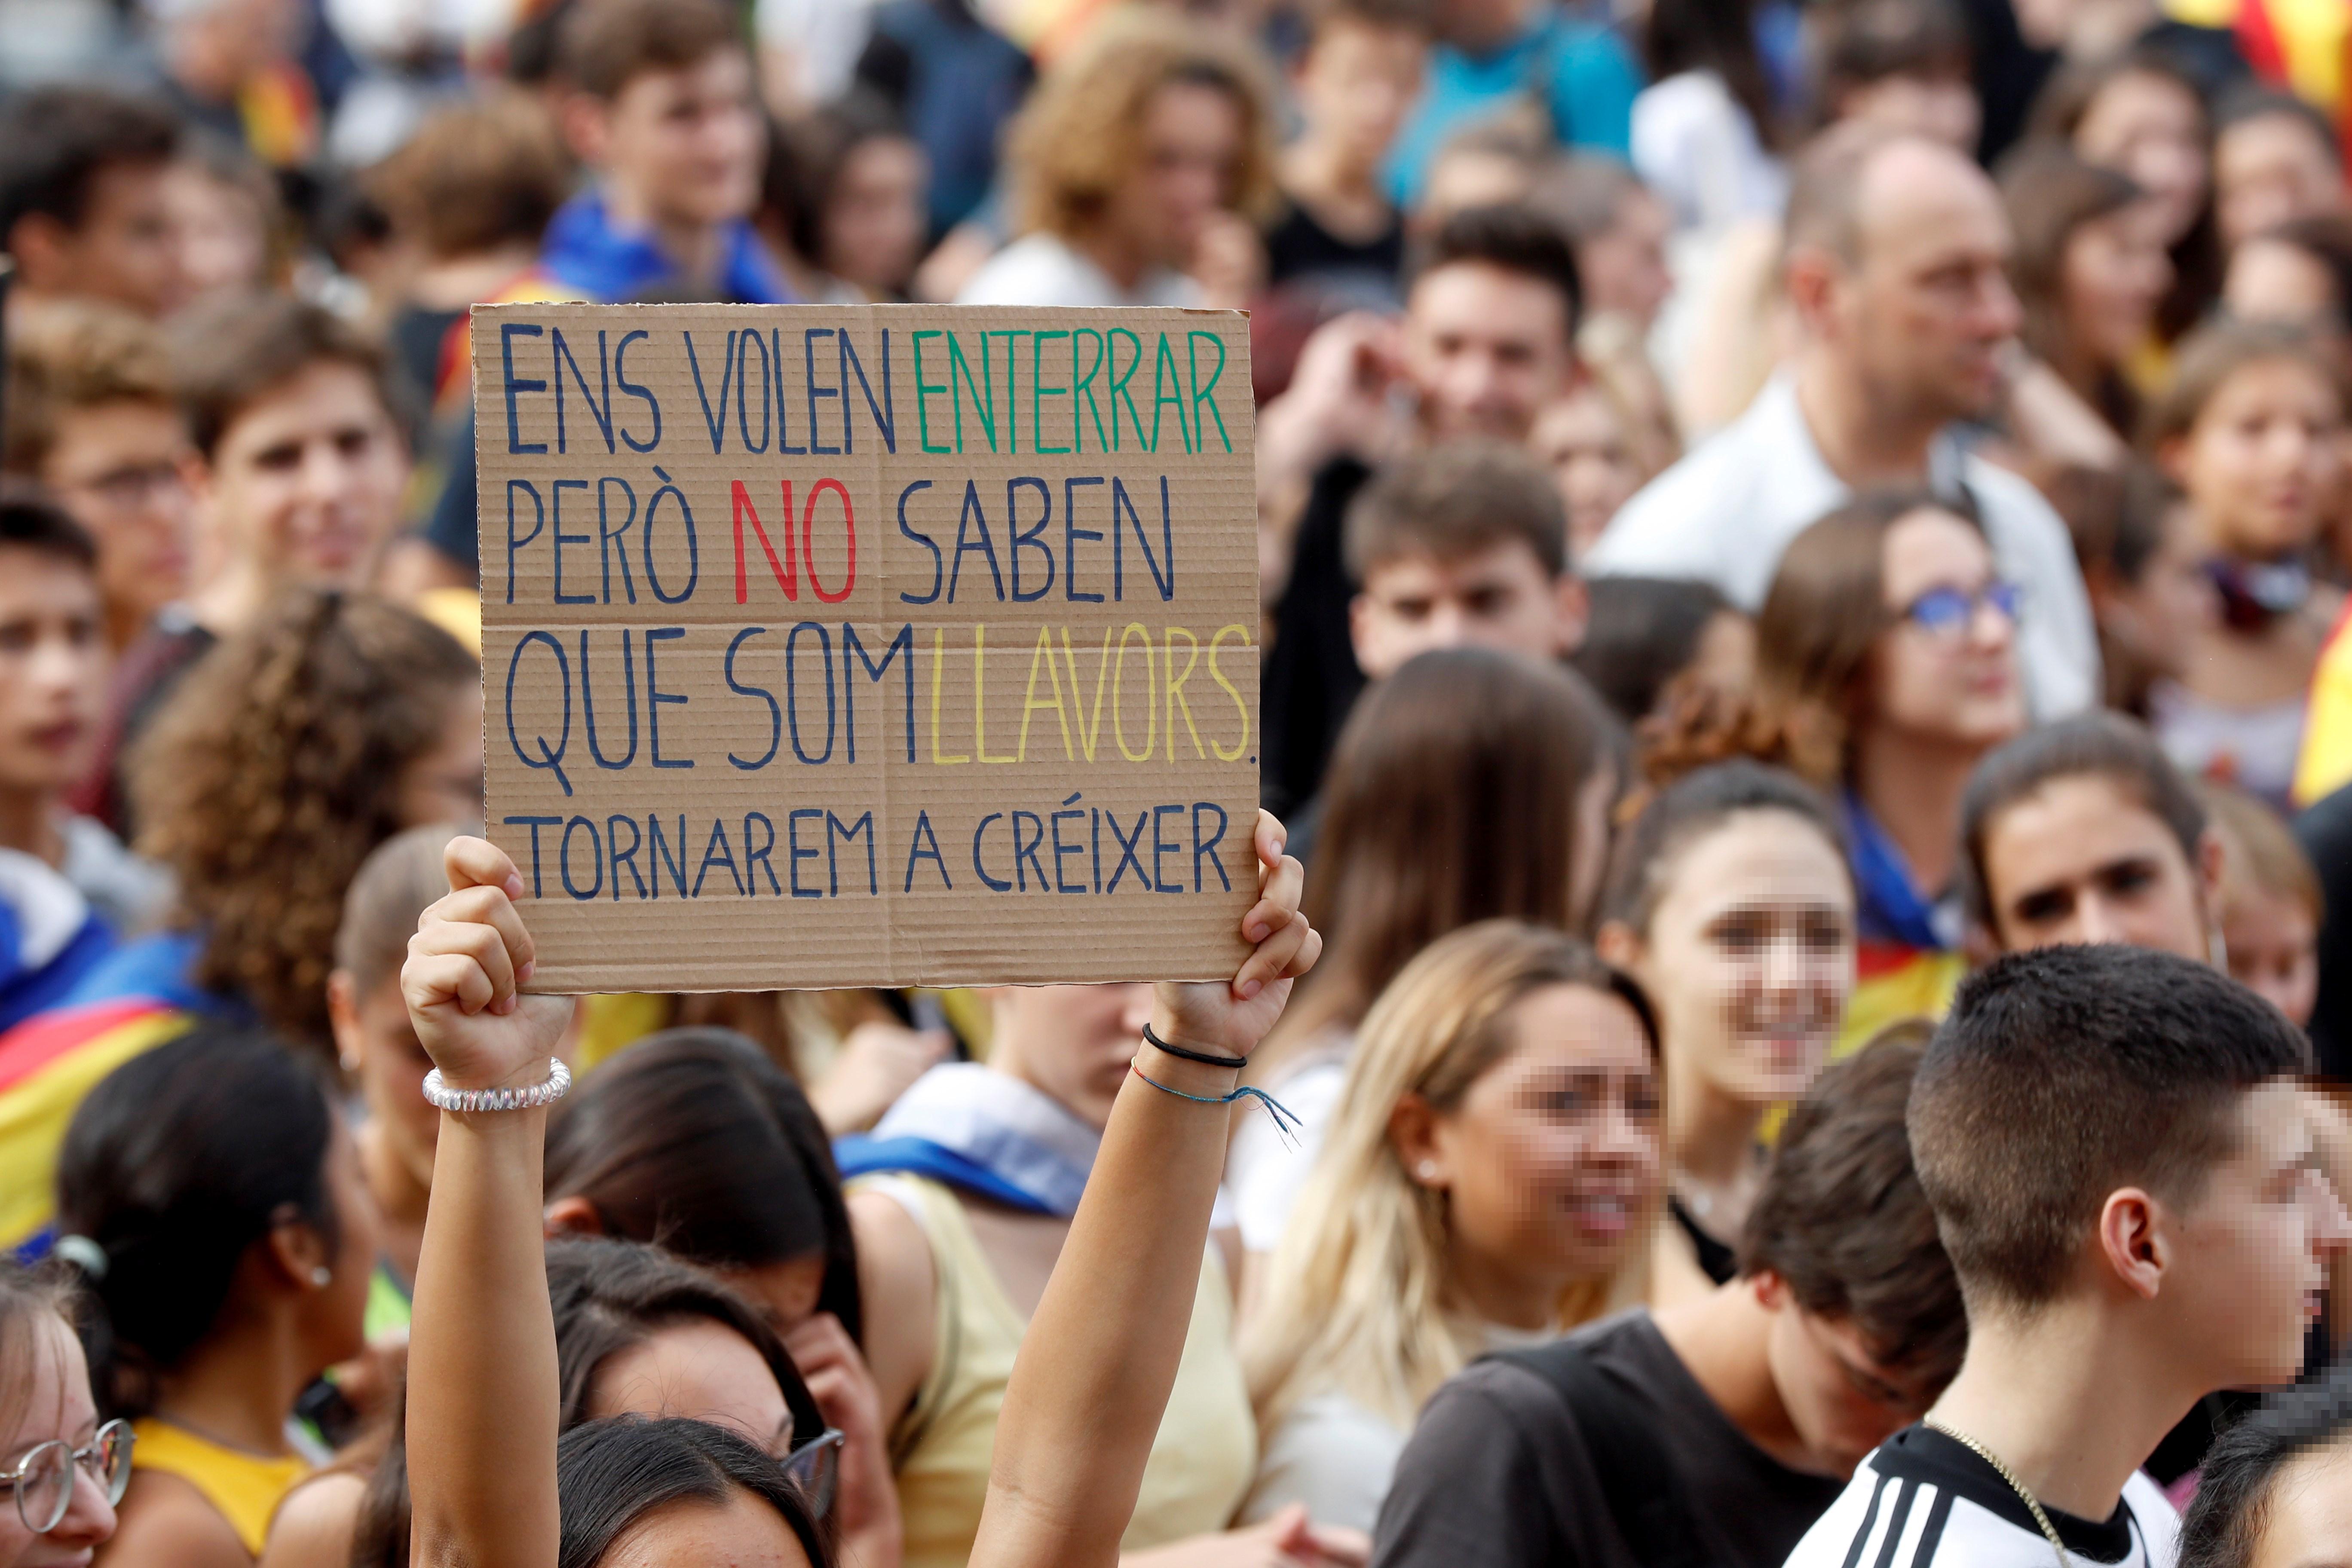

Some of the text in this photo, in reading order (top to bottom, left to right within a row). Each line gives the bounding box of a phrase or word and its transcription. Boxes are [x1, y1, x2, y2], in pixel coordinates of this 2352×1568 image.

[502, 324, 1233, 454] ENS VOLEN ENTERRAR
[507, 466, 1173, 604] PERÒ NO SABEN
[506, 628, 694, 796] QUE
[725, 622, 915, 770] SOM
[504, 793, 1231, 901] TORNAREM A CRÉIXER
